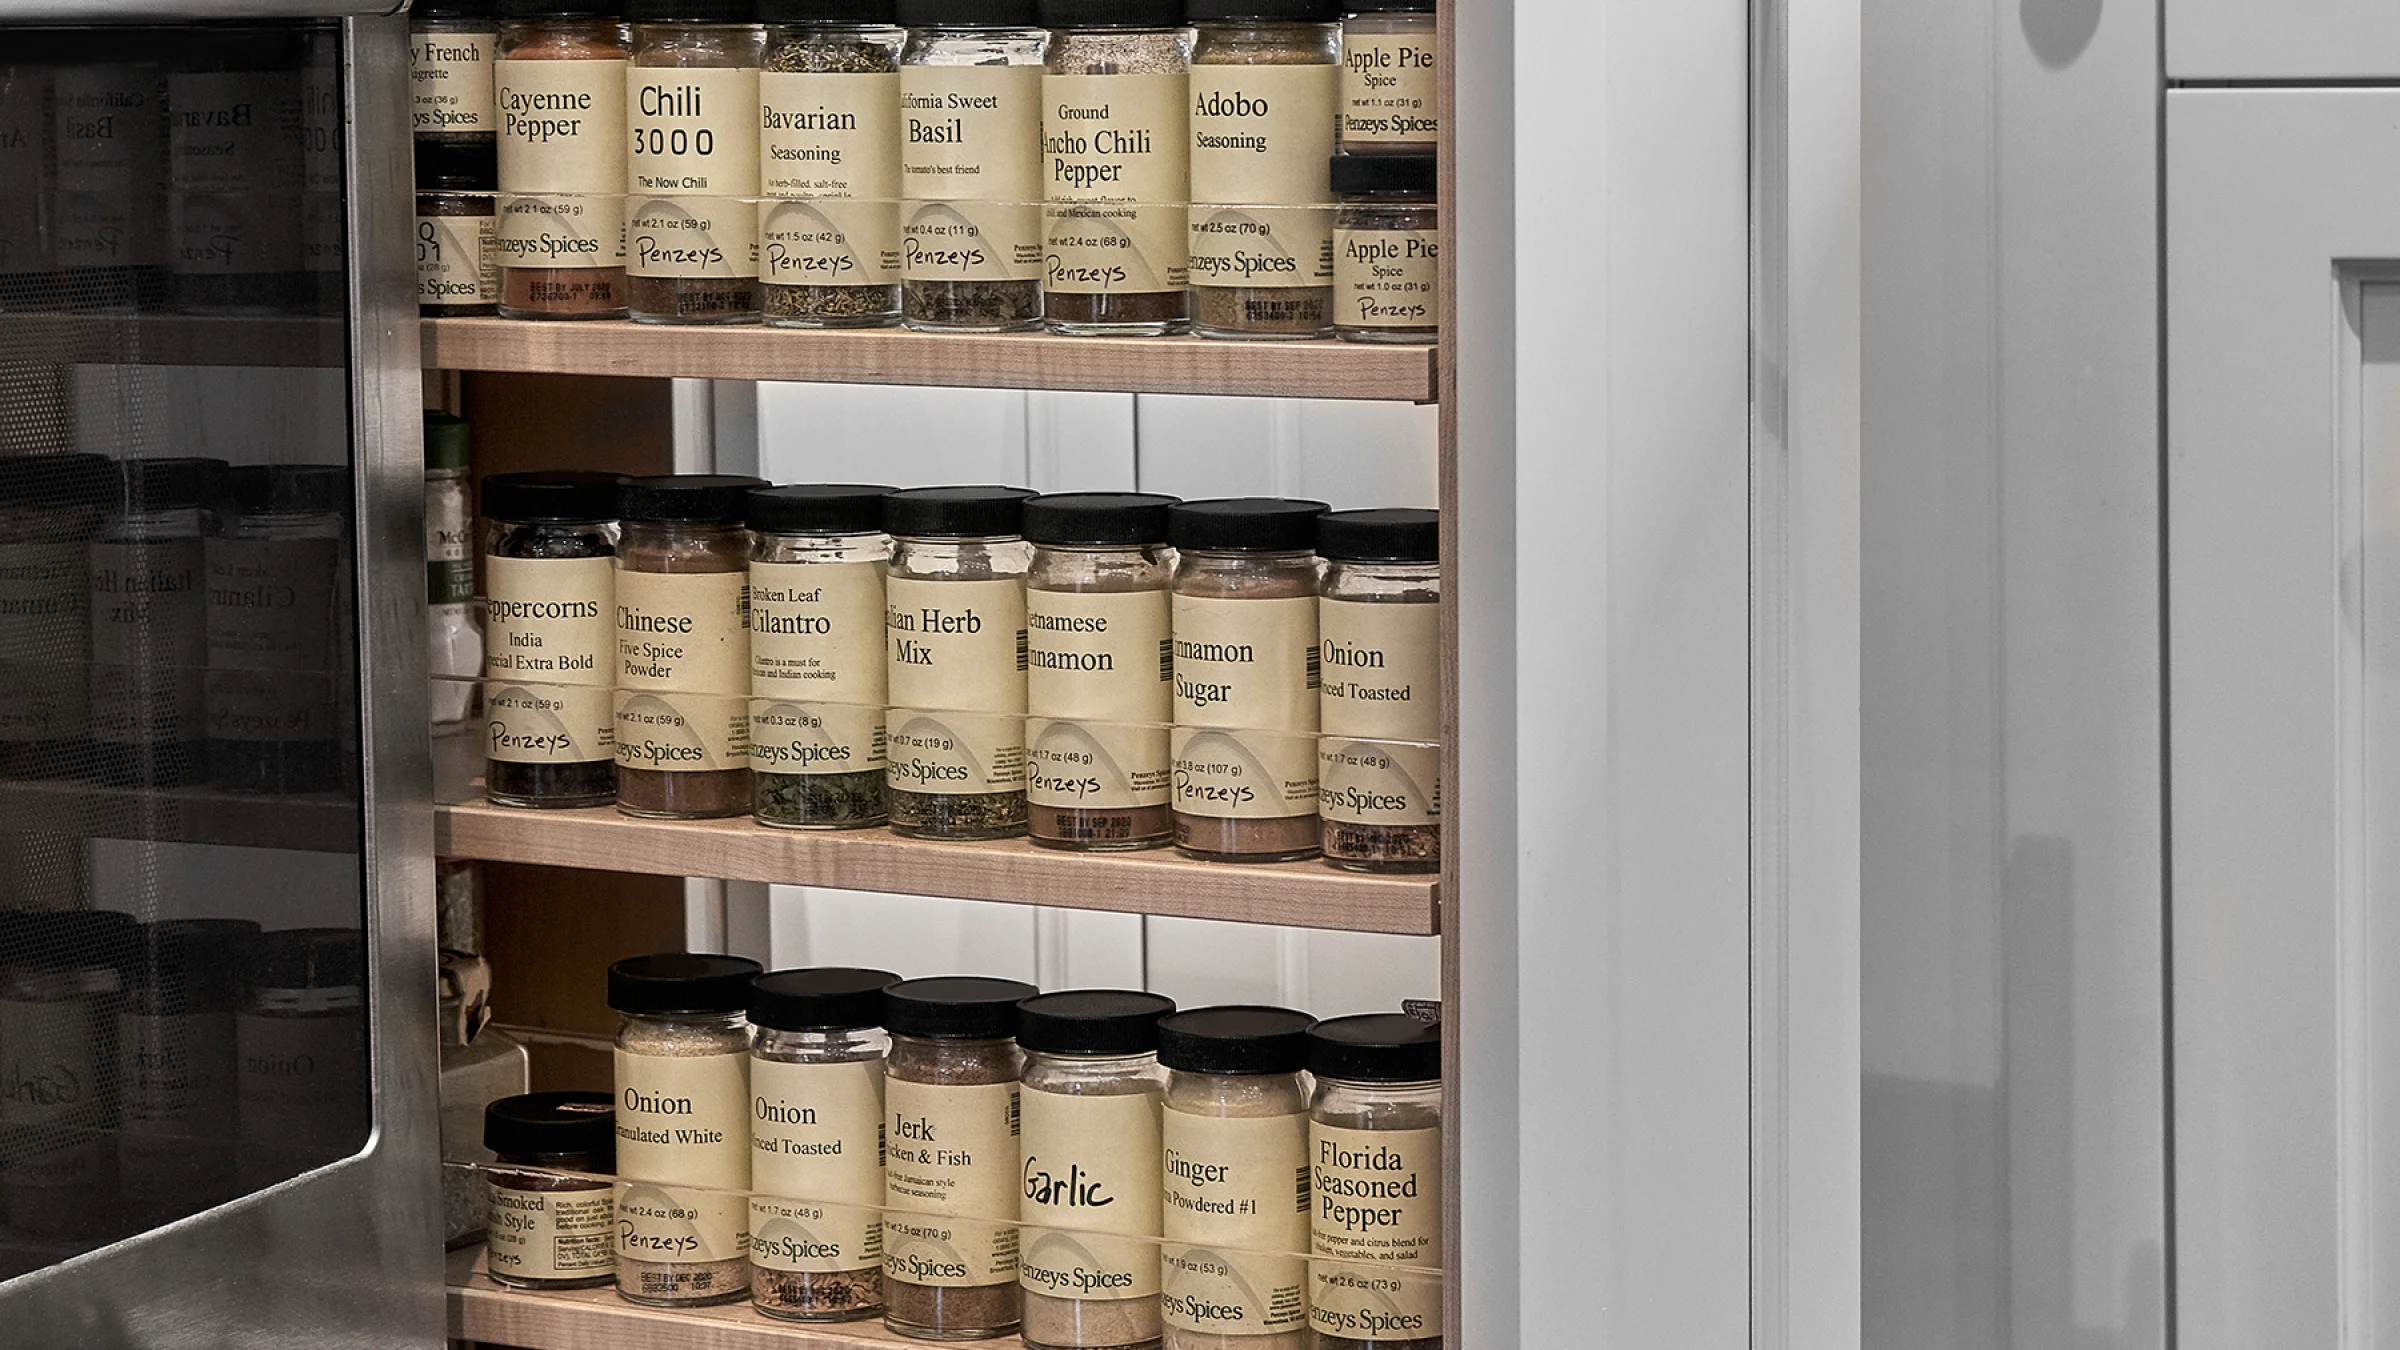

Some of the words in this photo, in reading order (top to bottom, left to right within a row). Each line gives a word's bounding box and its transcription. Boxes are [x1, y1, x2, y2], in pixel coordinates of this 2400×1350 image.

[425, 43, 480, 61] French
[1346, 48, 1390, 73] Apple
[1398, 48, 1433, 68] Pie
[1364, 73, 1396, 89] Spice
[500, 87, 592, 117] Cayenne
[640, 85, 701, 117] Chili
[947, 92, 998, 110] Sweet
[1059, 104, 1109, 120] Ground
[1195, 92, 1268, 117] Adobo
[433, 108, 478, 127] Spices
[506, 113, 581, 143] Pepper
[763, 106, 857, 130] Bavarian
[1391, 114, 1437, 134] Spices
[634, 128, 714, 155] 3000
[909, 118, 963, 143] Basil
[1094, 129, 1152, 154] Chili
[1196, 132, 1267, 152] Seasoning
[771, 145, 842, 164] Seasoning
[955, 165, 980, 175] friend
[1055, 158, 1122, 188] Pepper
[638, 176, 653, 188] The
[656, 177, 679, 188] Now
[682, 176, 707, 188] Chili
[554, 204, 570, 215] (59
[1103, 209, 1137, 220] cooking
[651, 219, 665, 228] 2.1
[667, 220, 678, 228] oz
[681, 219, 698, 230] (59
[700, 220, 711, 231] g)
[935, 227, 945, 235] oz
[948, 225, 964, 236] (11
[967, 226, 979, 237] g)
[1225, 224, 1236, 233] oz
[1239, 223, 1256, 235] (70
[1258, 224, 1270, 236] g)
[541, 233, 599, 259] Spices
[786, 232, 799, 241] 1.5
[802, 233, 813, 241] oz
[816, 232, 832, 243] (42
[834, 233, 845, 243] g)
[1069, 237, 1082, 247] 2.4
[1085, 238, 1098, 247] oz
[1119, 238, 1131, 248] g)
[636, 235, 724, 269] Penzeys
[766, 243, 853, 277] Penzeys
[904, 237, 984, 271] Penzeys
[1346, 239, 1399, 263] Apple
[1405, 239, 1438, 258] Pie
[1046, 255, 1126, 288] Penzeys
[1234, 250, 1296, 278] Spices
[1372, 265, 1403, 278] Spice
[428, 278, 476, 299] Spices
[1392, 283, 1402, 291] oz
[1357, 296, 1426, 320] Penzeys
[753, 586, 785, 603] Broken
[788, 588, 822, 603] Leaf
[488, 600, 598, 624] eppercorns
[616, 605, 693, 634] Chinese
[752, 608, 831, 635] Cilantro
[921, 608, 981, 634] Herb
[1029, 613, 1107, 633] etnamese
[509, 632, 542, 648] India
[619, 639, 640, 656] Five
[643, 643, 683, 661] Spice
[1175, 639, 1254, 663] nnamon
[516, 655, 553, 670] Extra
[559, 654, 594, 669] Bold
[788, 658, 806, 667] must
[896, 638, 933, 665] Mix
[1028, 649, 1113, 671] nnamon
[1323, 639, 1385, 668] Onion
[624, 660, 672, 678] Powder
[803, 670, 836, 681] cooking
[1176, 672, 1232, 707] Sugar
[1348, 683, 1411, 701] Toasted
[522, 699, 533, 709] oz
[644, 714, 654, 724] oz
[656, 714, 672, 725] (59
[674, 715, 684, 727] g)
[770, 715, 783, 725] 0.3
[786, 717, 796, 726] oz
[488, 721, 570, 754] Penzeys
[912, 737, 923, 747] oz
[643, 740, 703, 766] Spices
[791, 741, 850, 766] Spices
[1051, 752, 1062, 762] oz
[1064, 751, 1080, 763] (48
[1346, 757, 1357, 765] oz
[1360, 756, 1375, 766] (48
[912, 758, 968, 783] Spices
[1195, 763, 1205, 772] oz
[1207, 762, 1228, 774] (107
[1028, 761, 1100, 799] Penzeys
[1174, 769, 1254, 808] Penzeys
[1346, 786, 1405, 814] Spices
[624, 1087, 693, 1115] Onion
[755, 1096, 817, 1125] Onion
[676, 1129, 723, 1144] White
[895, 1112, 935, 1142] Jerk
[781, 1139, 842, 1155] Toasted
[918, 1150, 931, 1164] &
[937, 1150, 972, 1166] Fish
[1320, 1139, 1403, 1172] Florida
[1166, 1148, 1229, 1186] Ginger
[1023, 1156, 1114, 1208] Garlic
[1315, 1165, 1418, 1199] Seasoned
[497, 1192, 544, 1211] Smoked
[639, 1205, 653, 1216] 2.4
[654, 1208, 666, 1217] oz
[781, 1207, 792, 1216] oz
[1173, 1191, 1234, 1215] Powdered
[1239, 1198, 1257, 1215] #1
[504, 1212, 535, 1232] Style
[1322, 1196, 1402, 1232] Pepper
[618, 1220, 698, 1256] Penzeys
[911, 1226, 921, 1236] oz
[1350, 1236, 1364, 1246] and
[1366, 1236, 1389, 1247] citrus
[1391, 1235, 1416, 1247] blend
[1418, 1236, 1429, 1246] for
[782, 1237, 840, 1263] Spices
[1378, 1250, 1393, 1260] and
[1395, 1250, 1418, 1260] salad
[908, 1254, 966, 1280] Spices
[1187, 1261, 1197, 1271] oz
[1073, 1267, 1133, 1293] Spices
[1339, 1277, 1355, 1287] 2.6
[1357, 1279, 1369, 1288] oz
[1371, 1279, 1389, 1291] (73
[1185, 1295, 1243, 1323] Spices
[1311, 1302, 1356, 1329] enzeys
[1360, 1308, 1423, 1336] Spices
